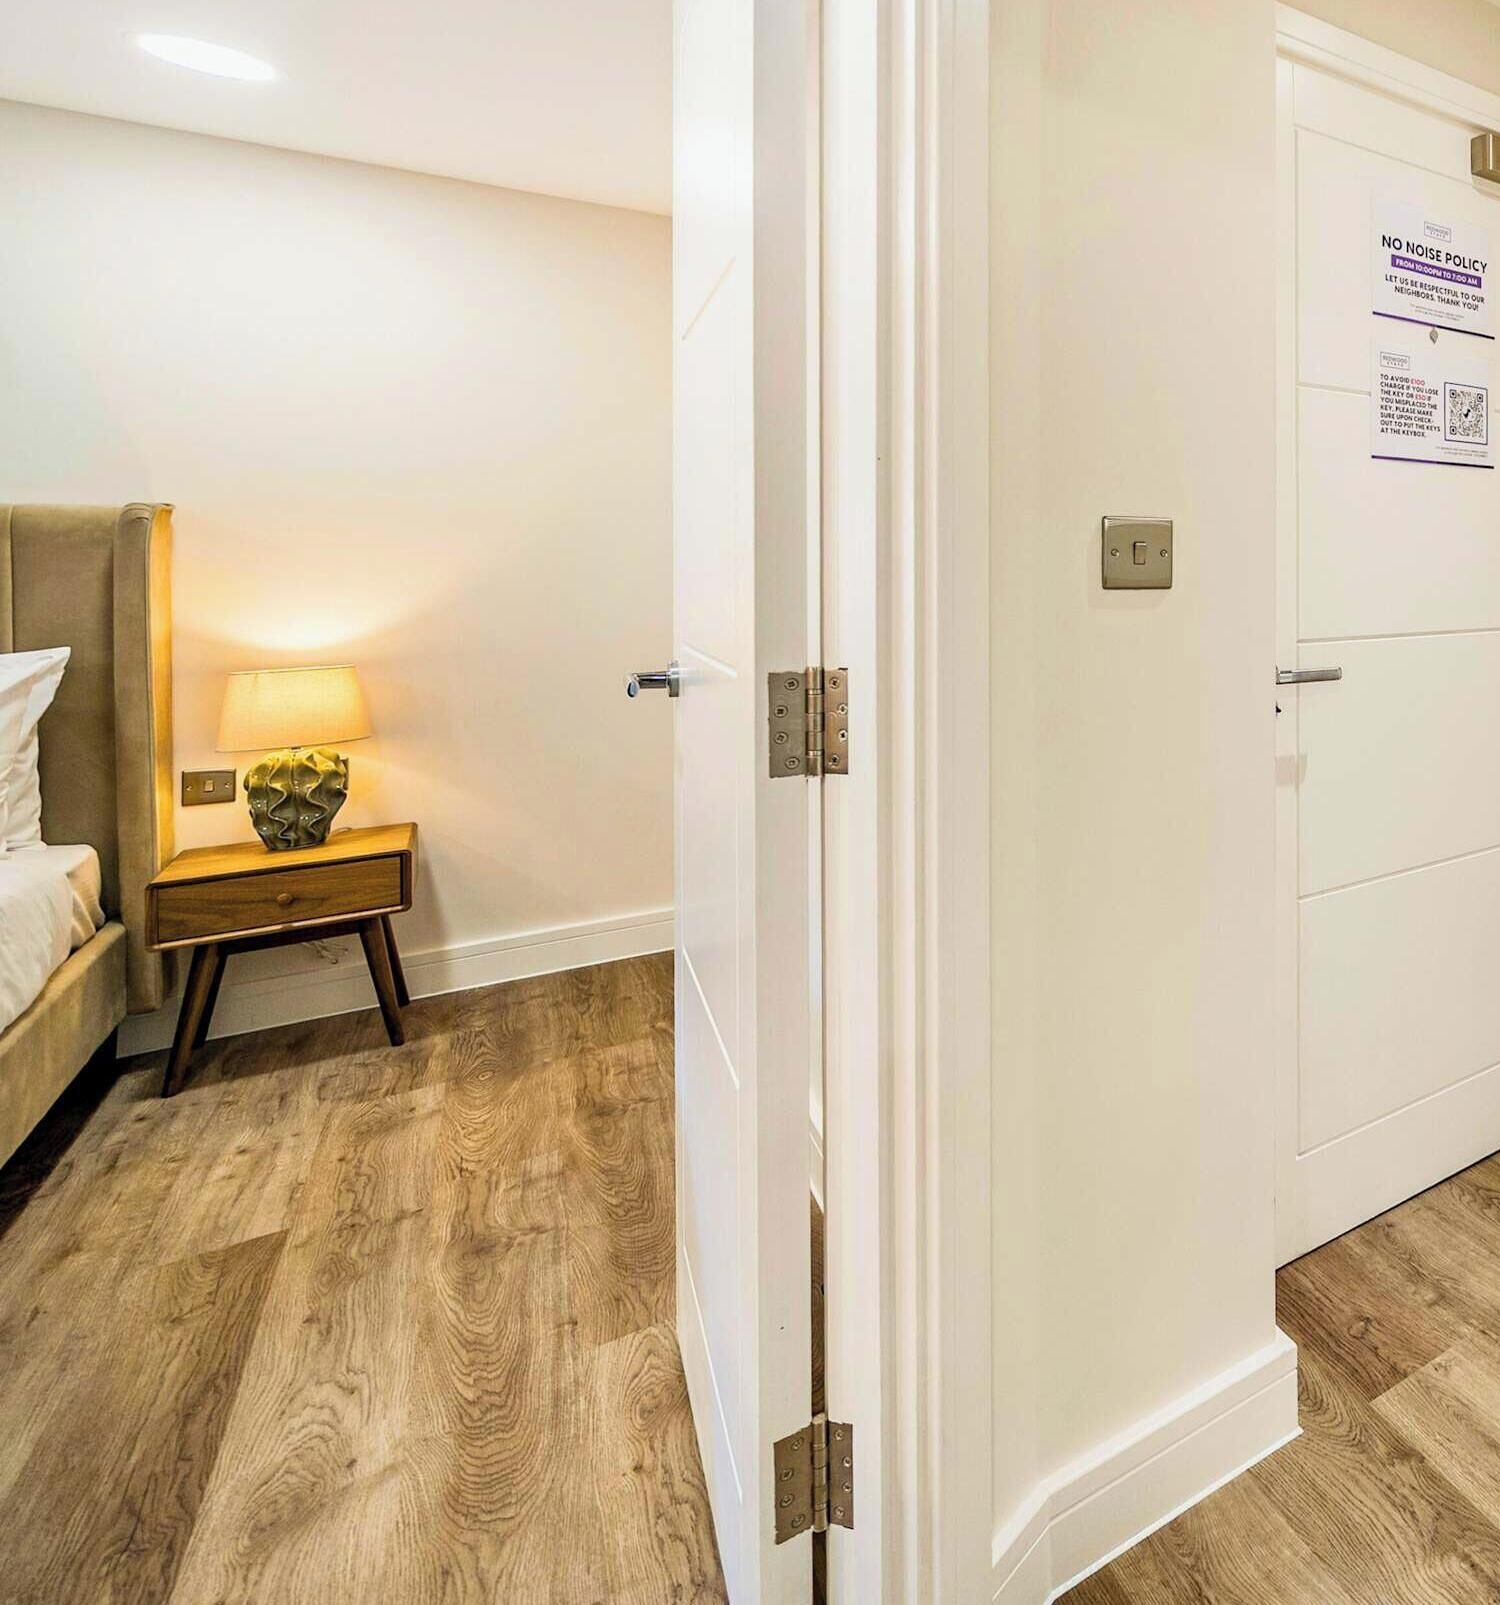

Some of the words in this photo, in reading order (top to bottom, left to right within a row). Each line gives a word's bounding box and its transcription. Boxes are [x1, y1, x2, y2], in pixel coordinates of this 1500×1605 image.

[1382, 234, 1402, 251] NO
[1406, 241, 1442, 262] NOISE
[1445, 252, 1488, 274] POLICY
[1395, 258, 1415, 270] FROM
[1443, 271, 1452, 280] TO
[1466, 277, 1478, 286] AM
[1385, 274, 1398, 283] LET
[1399, 277, 1409, 286] US
[1410, 280, 1418, 288] BE
[1419, 282, 1459, 298] RESPECTFUL
[1461, 292, 1470, 300] TO
[1471, 294, 1485, 304] OUR
[1437, 295, 1461, 307] THANK
[1462, 301, 1479, 312] YOU!
[1390, 375, 1410, 383] AVOID
[1380, 381, 1404, 390] CHARGE
[1395, 398, 1426, 407] MISPLACED
[1395, 406, 1416, 414] PLEASE
[1380, 411, 1394, 419] SURE
[1396, 413, 1412, 421] UPON
